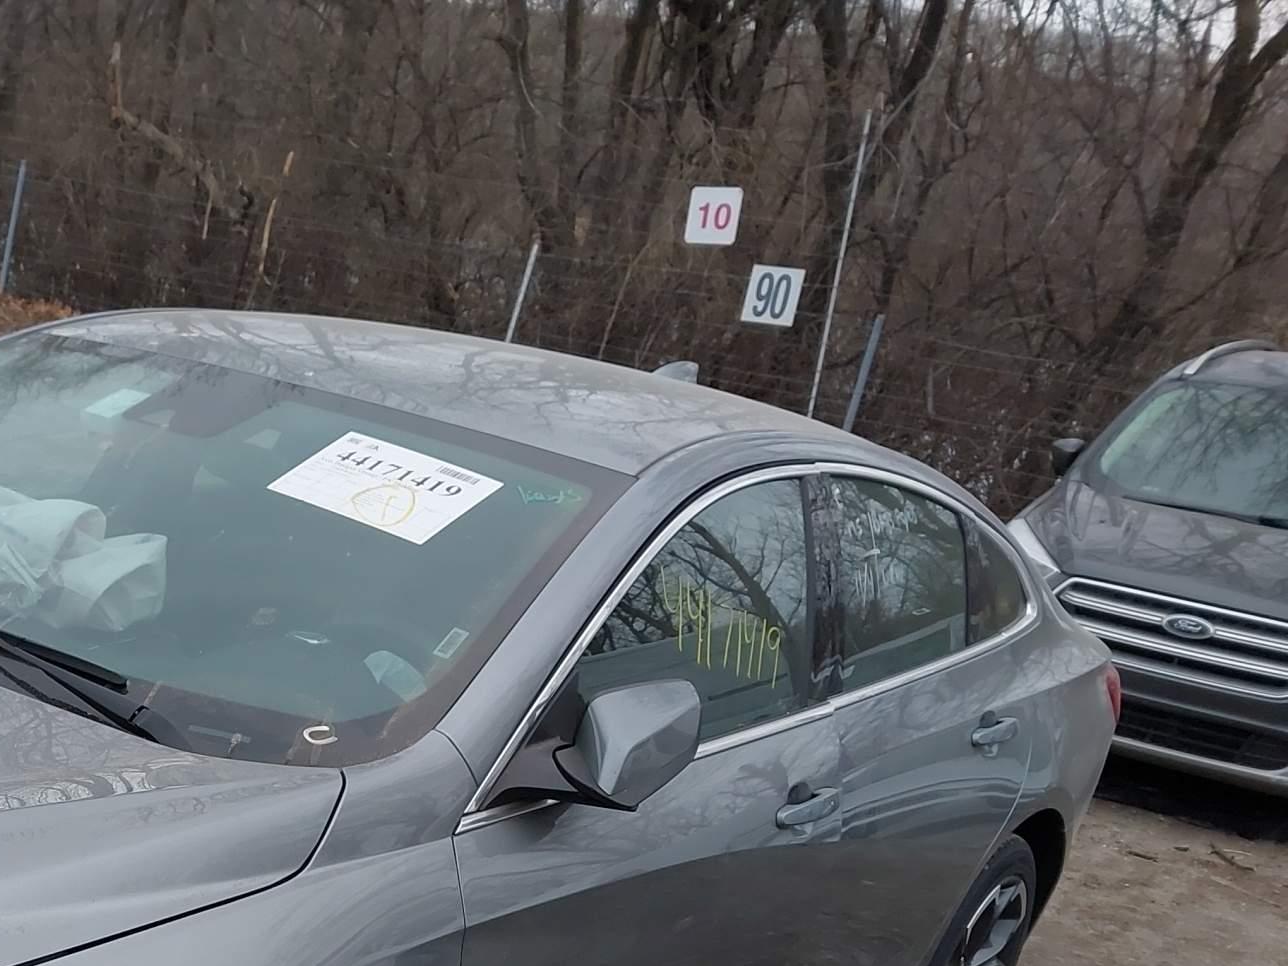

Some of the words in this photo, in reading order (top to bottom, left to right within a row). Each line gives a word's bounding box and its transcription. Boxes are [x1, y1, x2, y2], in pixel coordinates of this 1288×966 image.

[698, 202, 732, 230] 10
[752, 271, 792, 320] 90
[336, 450, 463, 497] 44171419
[660, 564, 782, 689] 44171419
